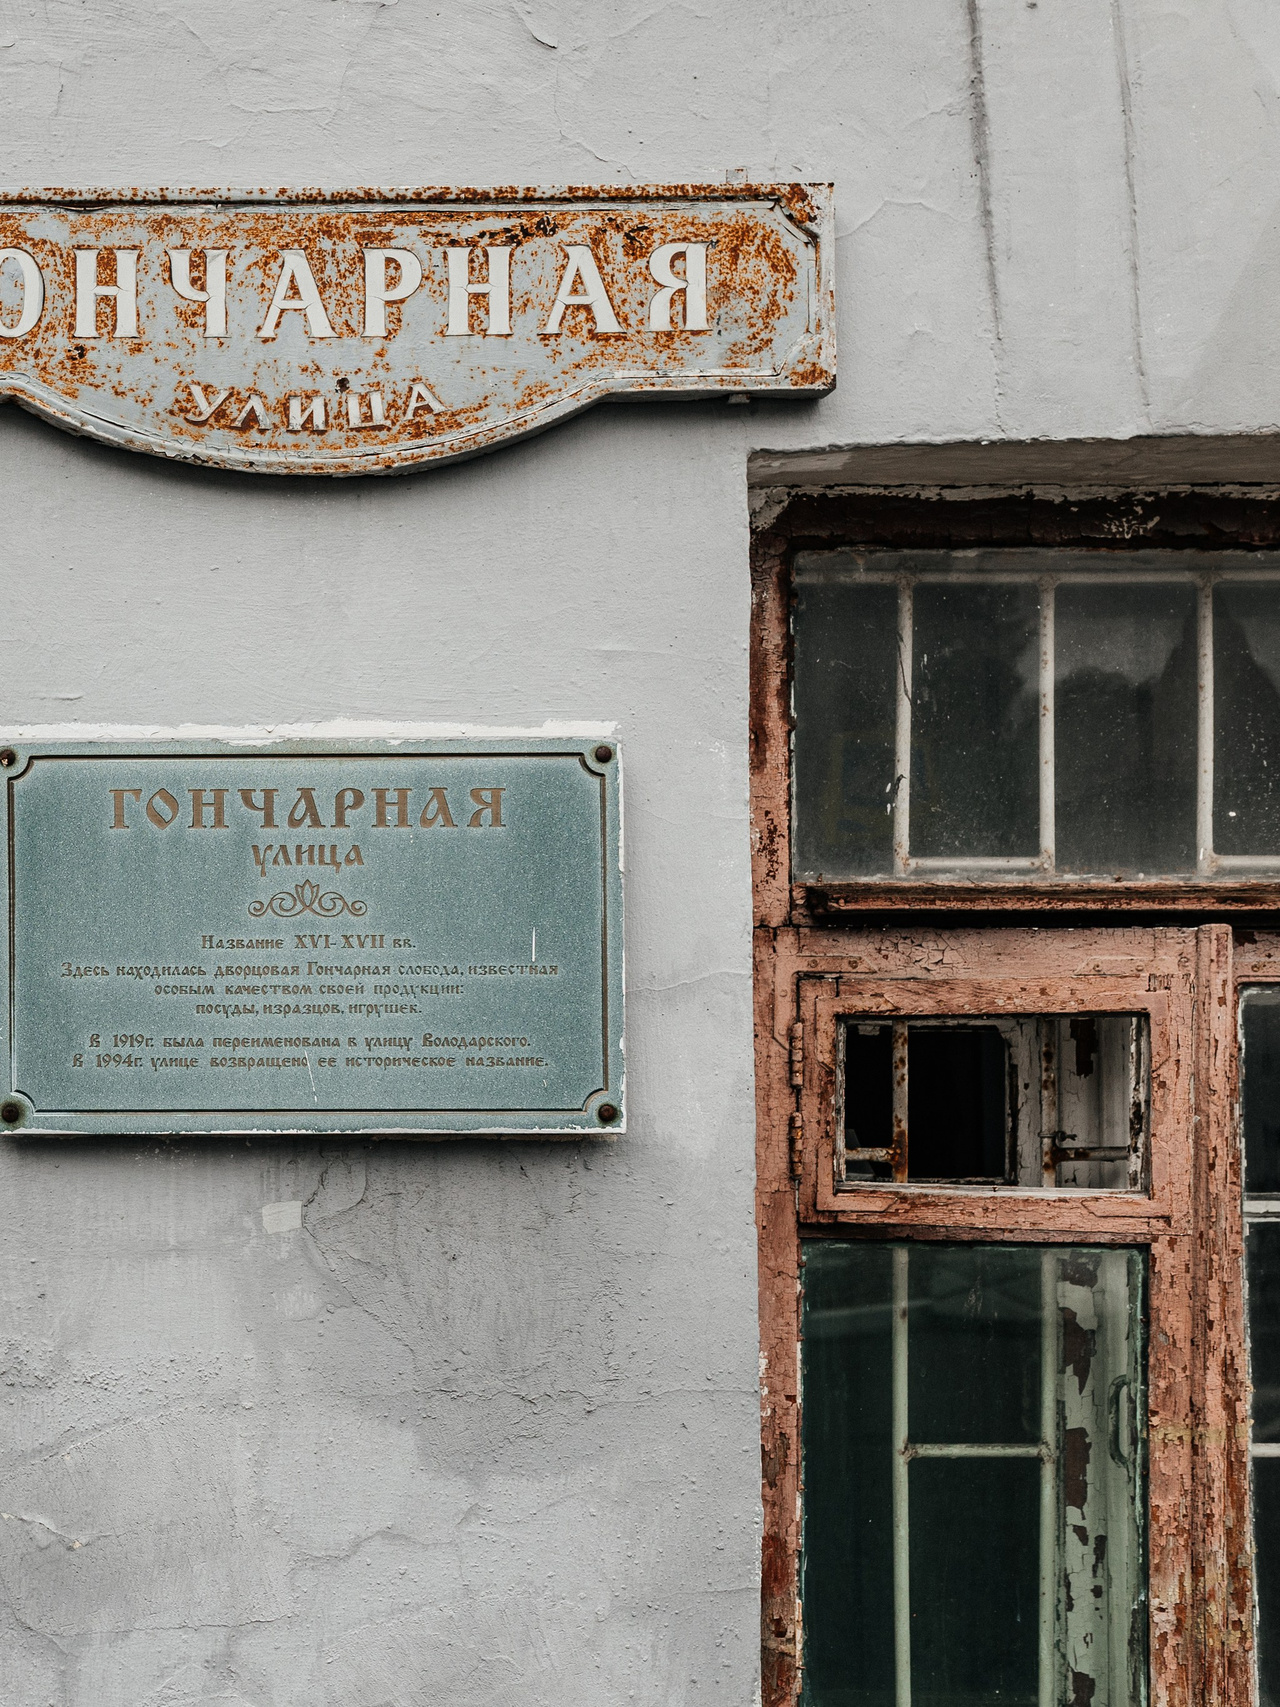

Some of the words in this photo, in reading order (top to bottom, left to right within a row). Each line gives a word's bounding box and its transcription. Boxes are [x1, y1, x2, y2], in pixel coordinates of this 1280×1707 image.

[185, 382, 453, 432] УЛИЦА
[108, 787, 507, 830] ГОНЧАРНАЯ
[201, 935, 284, 949] Название
[392, 938, 417, 949] вв.
[60, 961, 110, 980] Здесь
[116, 965, 207, 980] находилась
[213, 965, 301, 980] дворцовая
[307, 961, 391, 980] Гончарная
[398, 964, 464, 978] слобода,
[468, 964, 559, 977] известная
[154, 984, 215, 996] особым
[224, 984, 313, 996] качеством
[318, 981, 365, 996] своей
[373, 983, 465, 998] продукции:
[195, 1003, 260, 1018] посуды,
[262, 1003, 345, 1018] изразцов,
[348, 1003, 423, 1017] игрушек.
[88, 1033, 101, 1048] В
[112, 1033, 155, 1048] 1919г.
[163, 1037, 204, 1048] была
[212, 1036, 341, 1051] переименована
[347, 1036, 358, 1048] в
[364, 1036, 413, 1052] улицу
[421, 1033, 532, 1051] Володарского.
[71, 1053, 84, 1068] В
[95, 1053, 144, 1068] 1994г.
[150, 1056, 199, 1072] улице
[209, 1056, 309, 1071] возвращено
[317, 1056, 338, 1068] ее
[345, 1056, 457, 1071] историческое
[465, 1056, 550, 1068] название.
